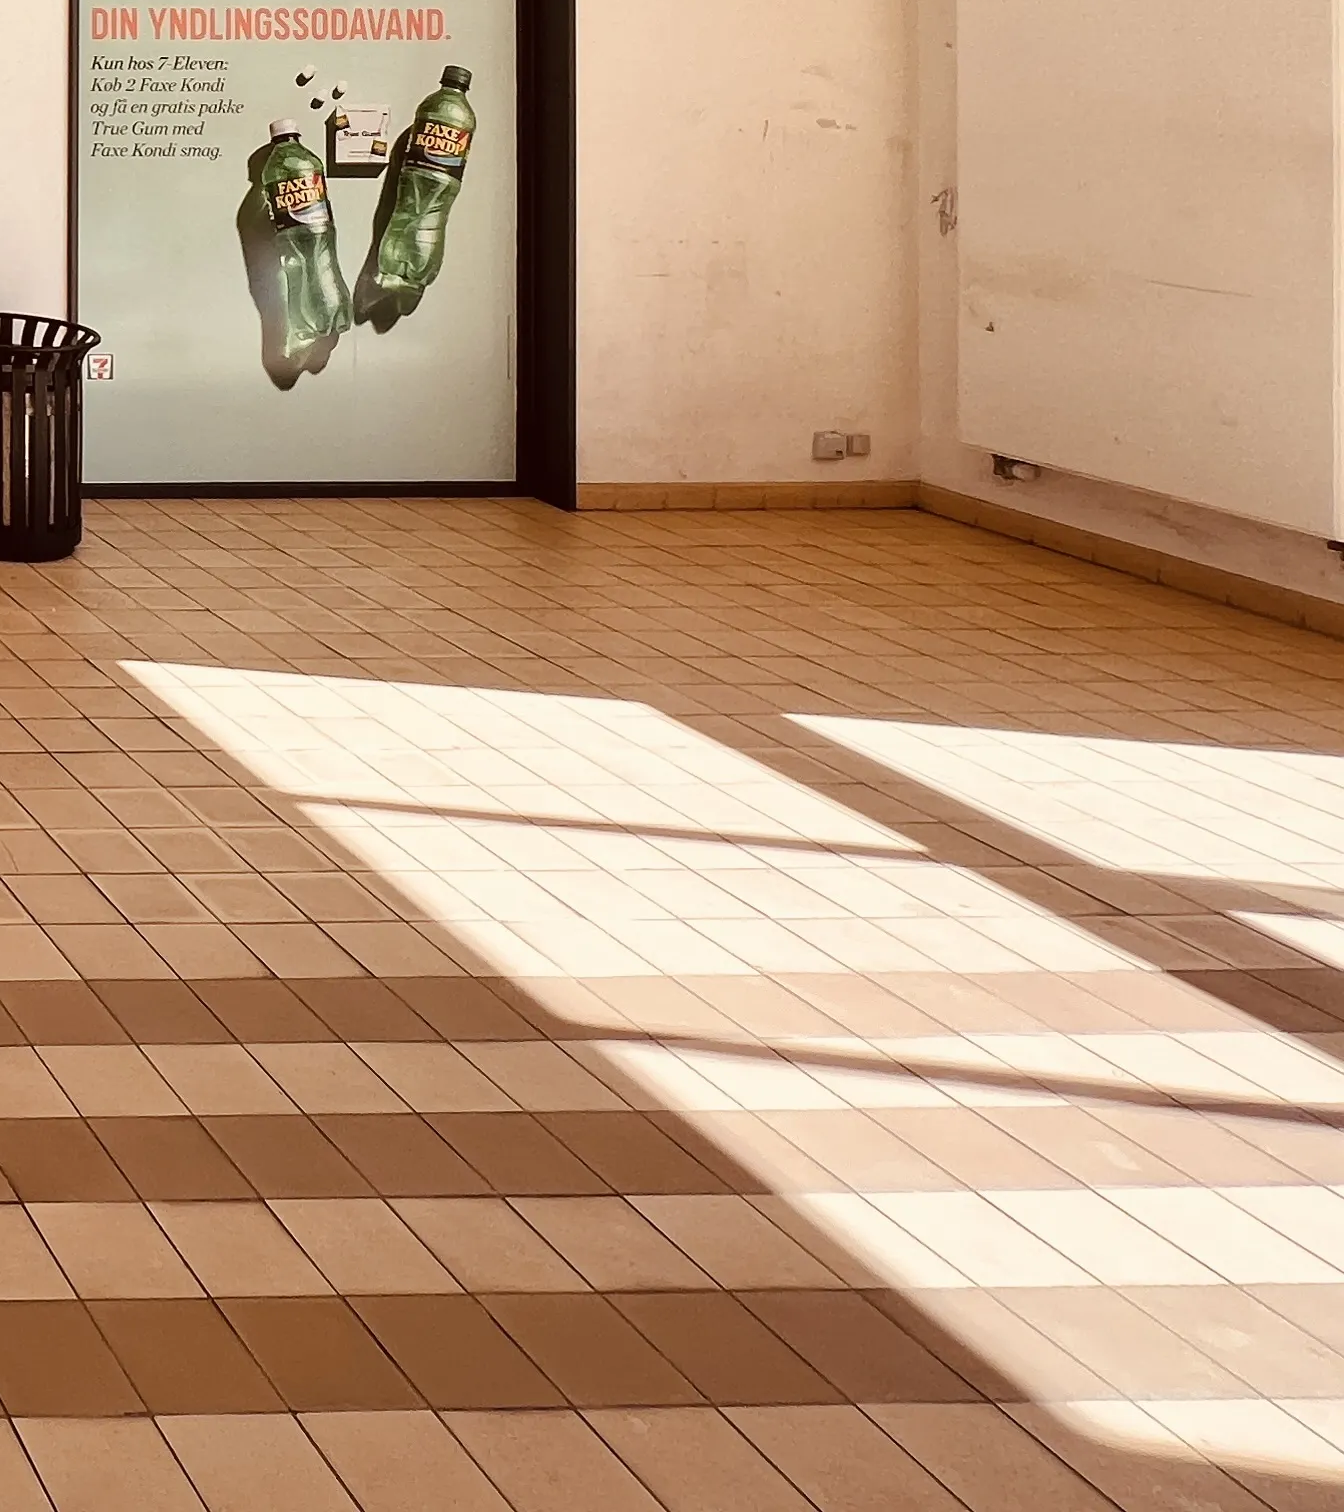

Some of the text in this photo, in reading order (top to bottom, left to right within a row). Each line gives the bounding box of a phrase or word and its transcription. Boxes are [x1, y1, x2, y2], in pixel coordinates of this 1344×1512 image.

[91, 7, 452, 41] DIN YNDLINGSSODAVAND.
[90, 55, 229, 71] Kun hos 7-Eleven:
[125, 78, 137, 92] 2
[139, 78, 177, 92] Faxe
[180, 77, 226, 92] Kondi
[90, 102, 109, 117] og
[130, 102, 148, 114] en
[151, 99, 196, 117] gratis
[198, 99, 245, 117] pakke
[91, 120, 205, 136] True Gum med
[423, 122, 461, 142] FAXE
[90, 142, 223, 161] Faxe Kondi smag.
[415, 134, 460, 156] KONDI
